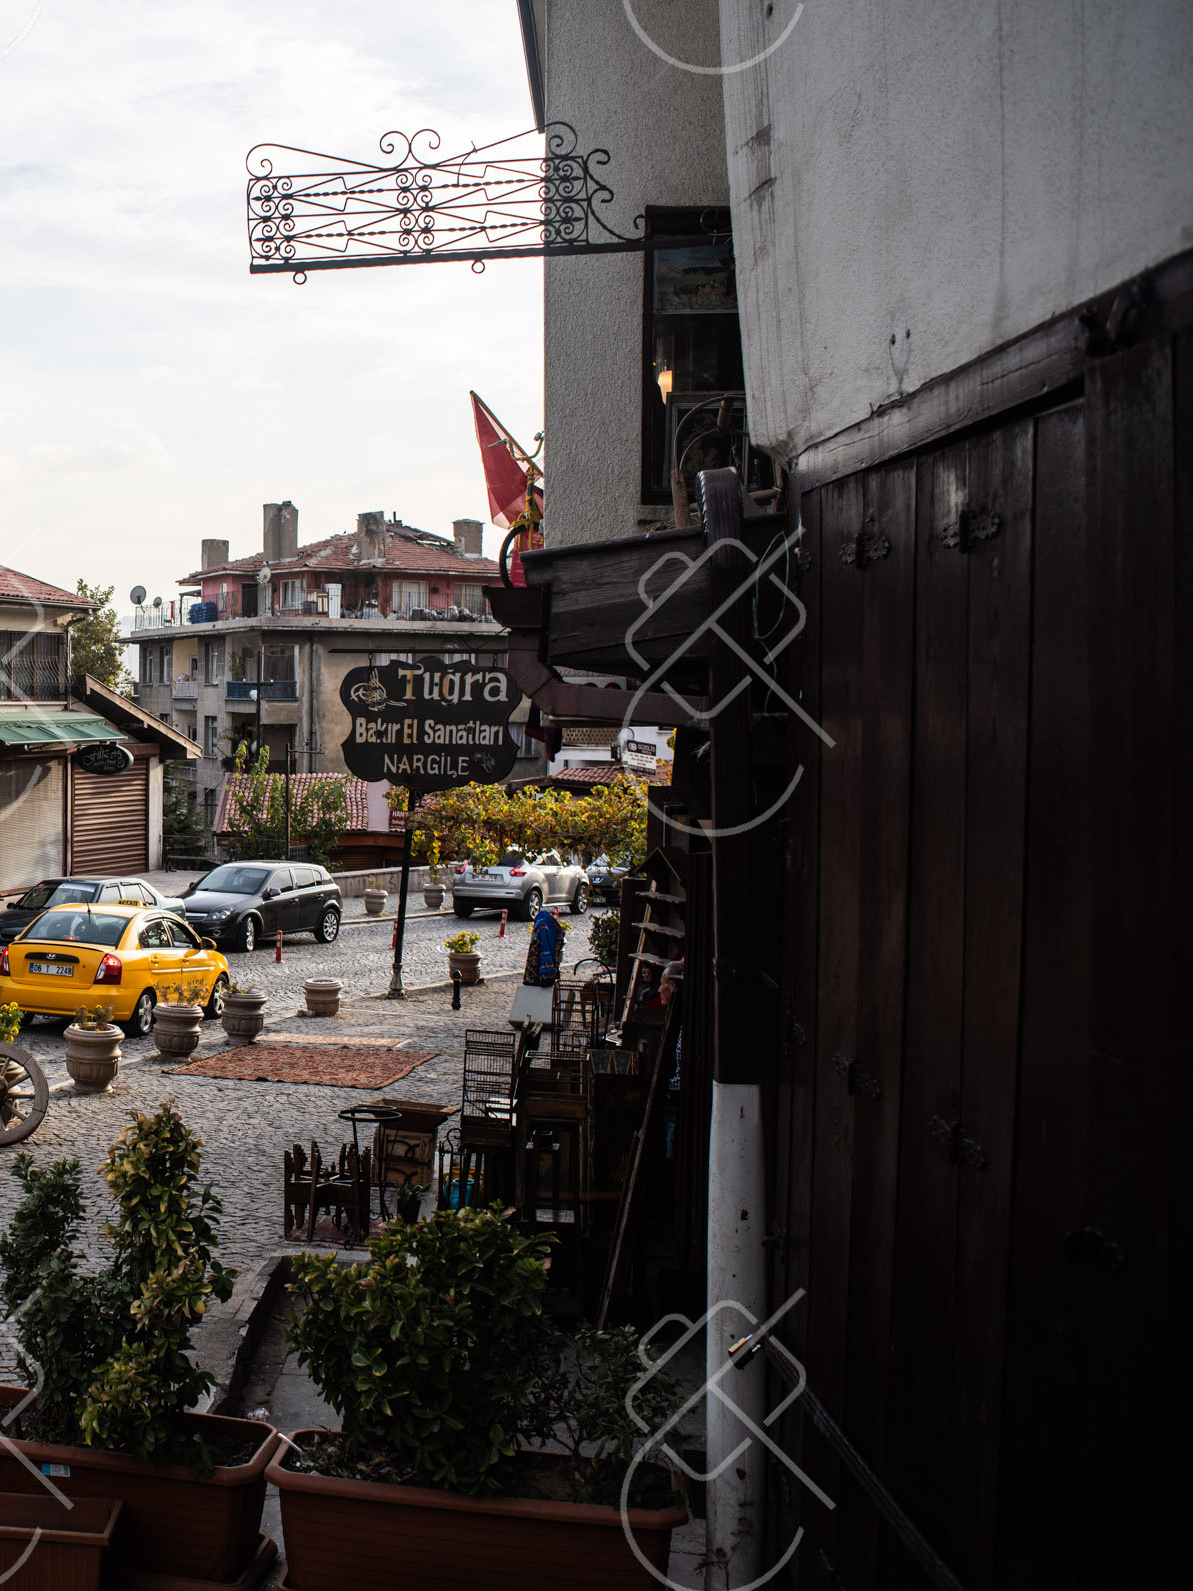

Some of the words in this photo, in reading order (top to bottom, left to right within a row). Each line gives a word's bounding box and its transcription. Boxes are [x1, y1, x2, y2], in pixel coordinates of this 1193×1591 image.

[398, 663, 509, 707] Tuğra
[355, 717, 401, 744] Bakır
[403, 719, 418, 744] El
[423, 719, 504, 746] Sanatları
[383, 752, 470, 779] NARGİLE
[33, 964, 42, 972] 06
[46, 965, 50, 973] T
[56, 966, 72, 975] 2248
